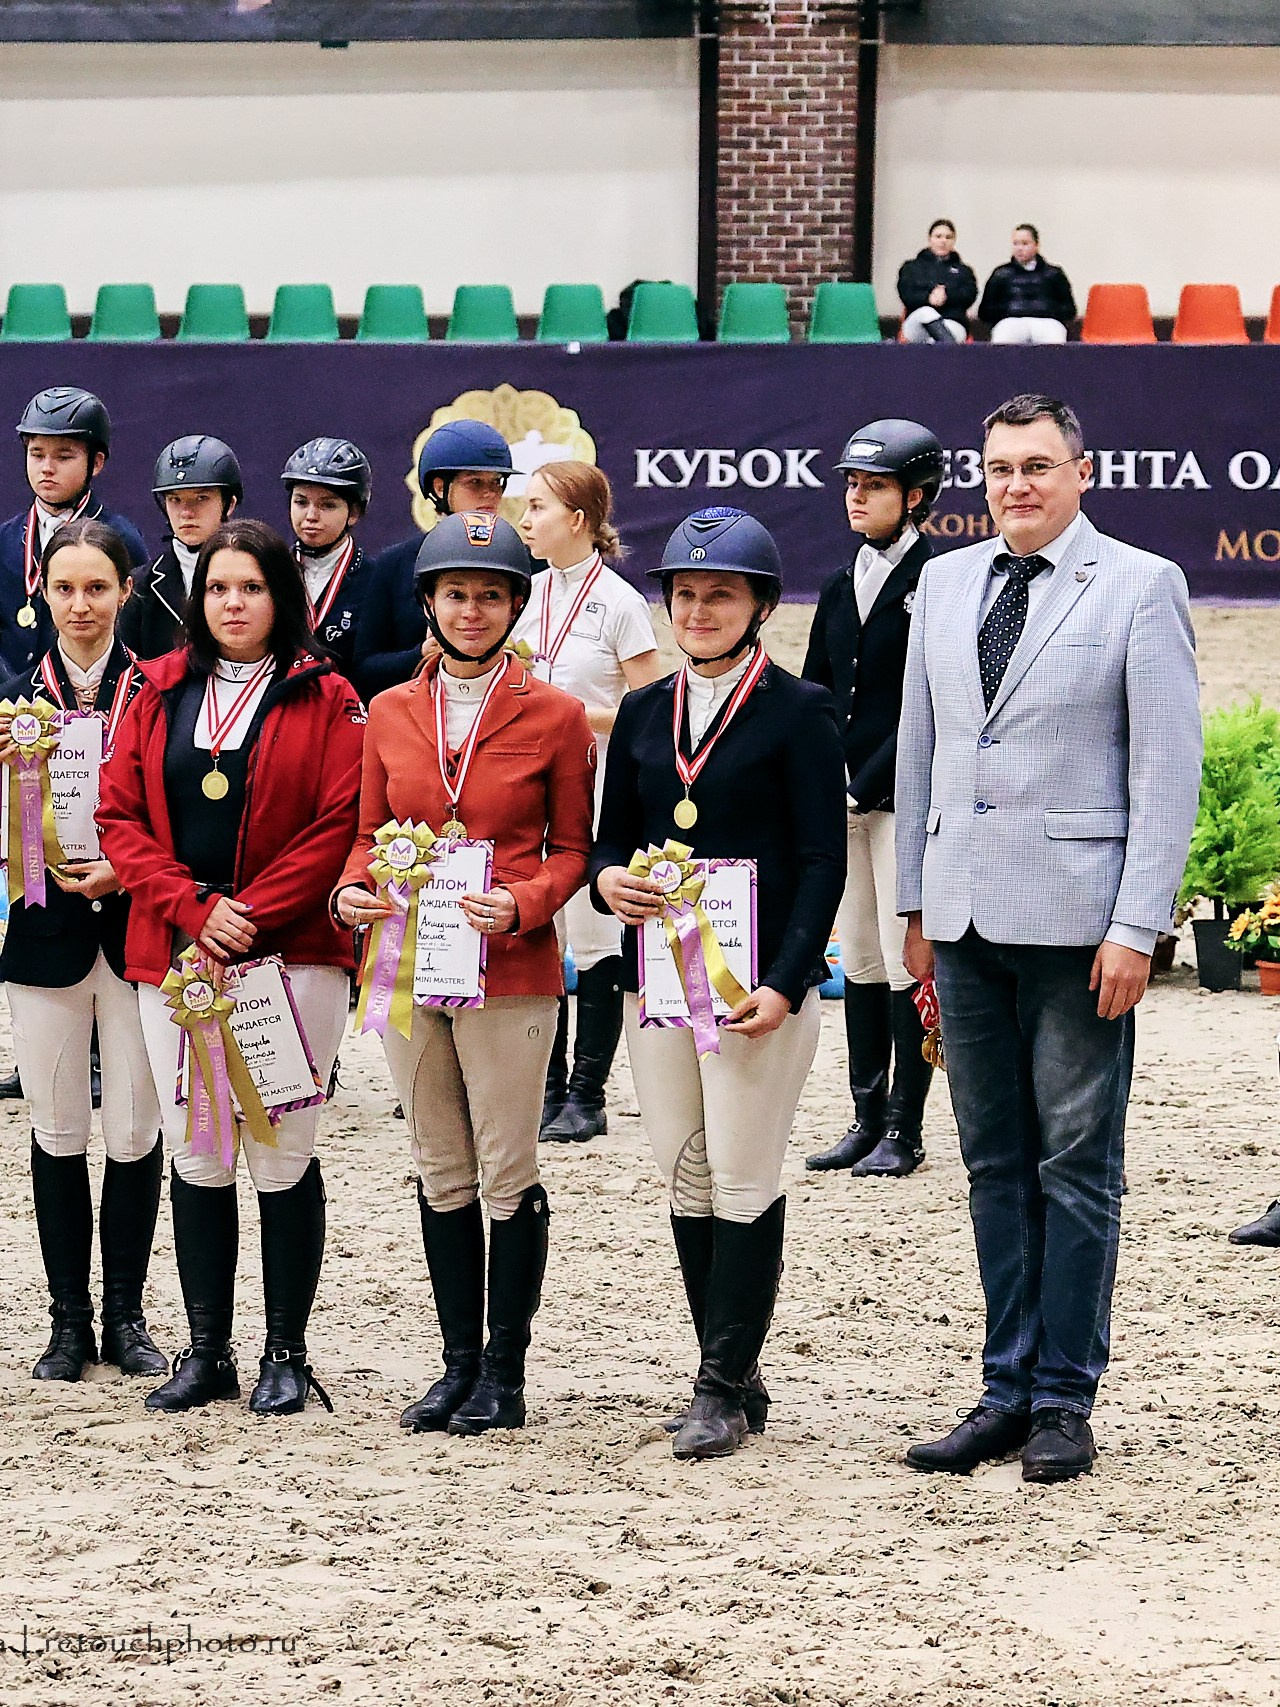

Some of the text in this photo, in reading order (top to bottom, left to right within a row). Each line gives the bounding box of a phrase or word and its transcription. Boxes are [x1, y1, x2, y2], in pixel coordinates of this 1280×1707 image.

[635, 448, 824, 488] КУБОК
[433, 977, 466, 985] MASTERS
[270, 1084, 302, 1098] MASTERS
